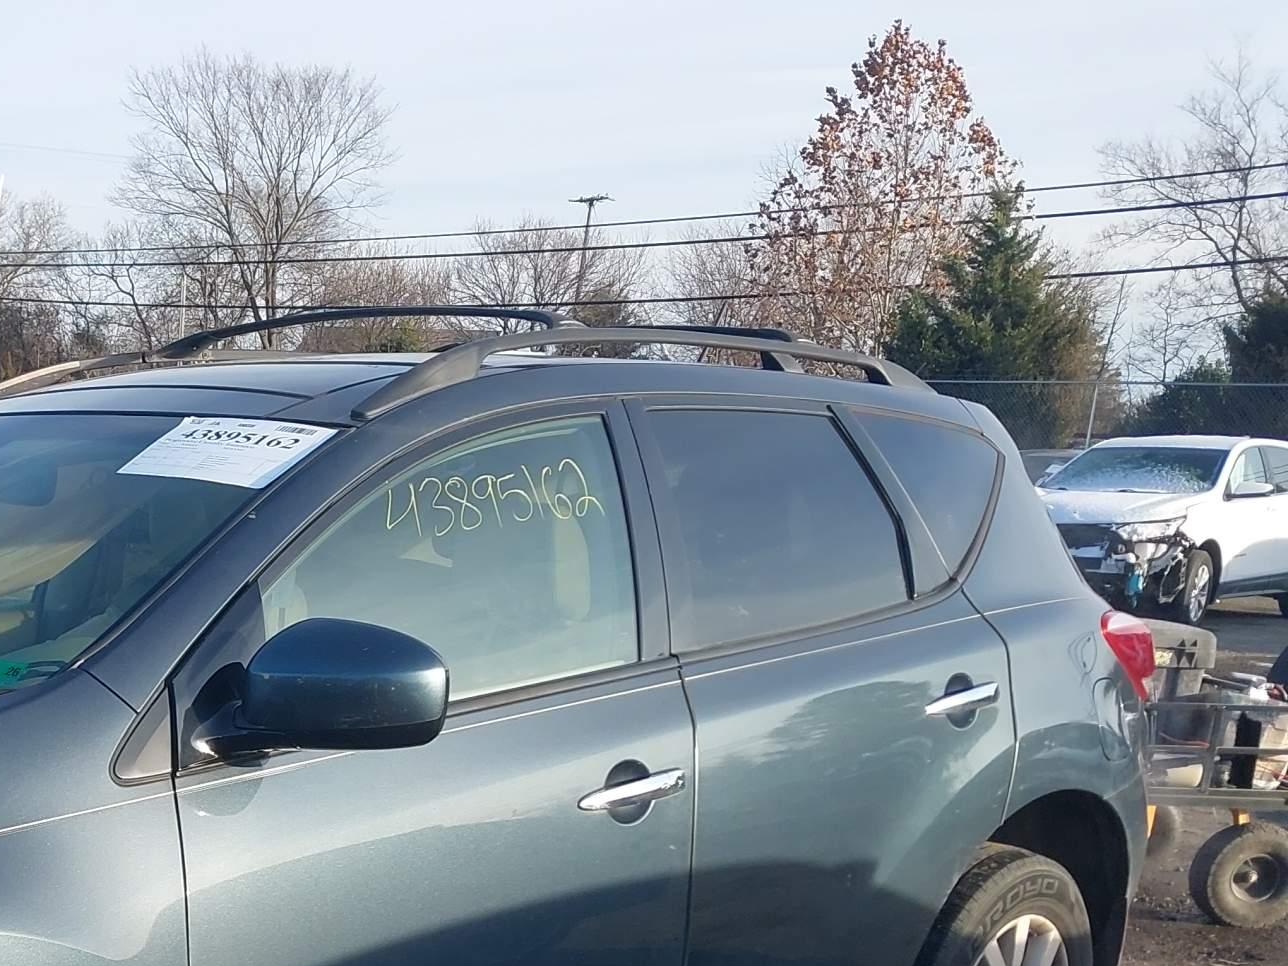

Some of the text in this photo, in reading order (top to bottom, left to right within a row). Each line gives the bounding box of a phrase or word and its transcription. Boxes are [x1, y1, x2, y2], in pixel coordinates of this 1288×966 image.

[181, 427, 301, 450] 43895162
[385, 458, 606, 537] 43895162
[7, 667, 21, 677] 26
